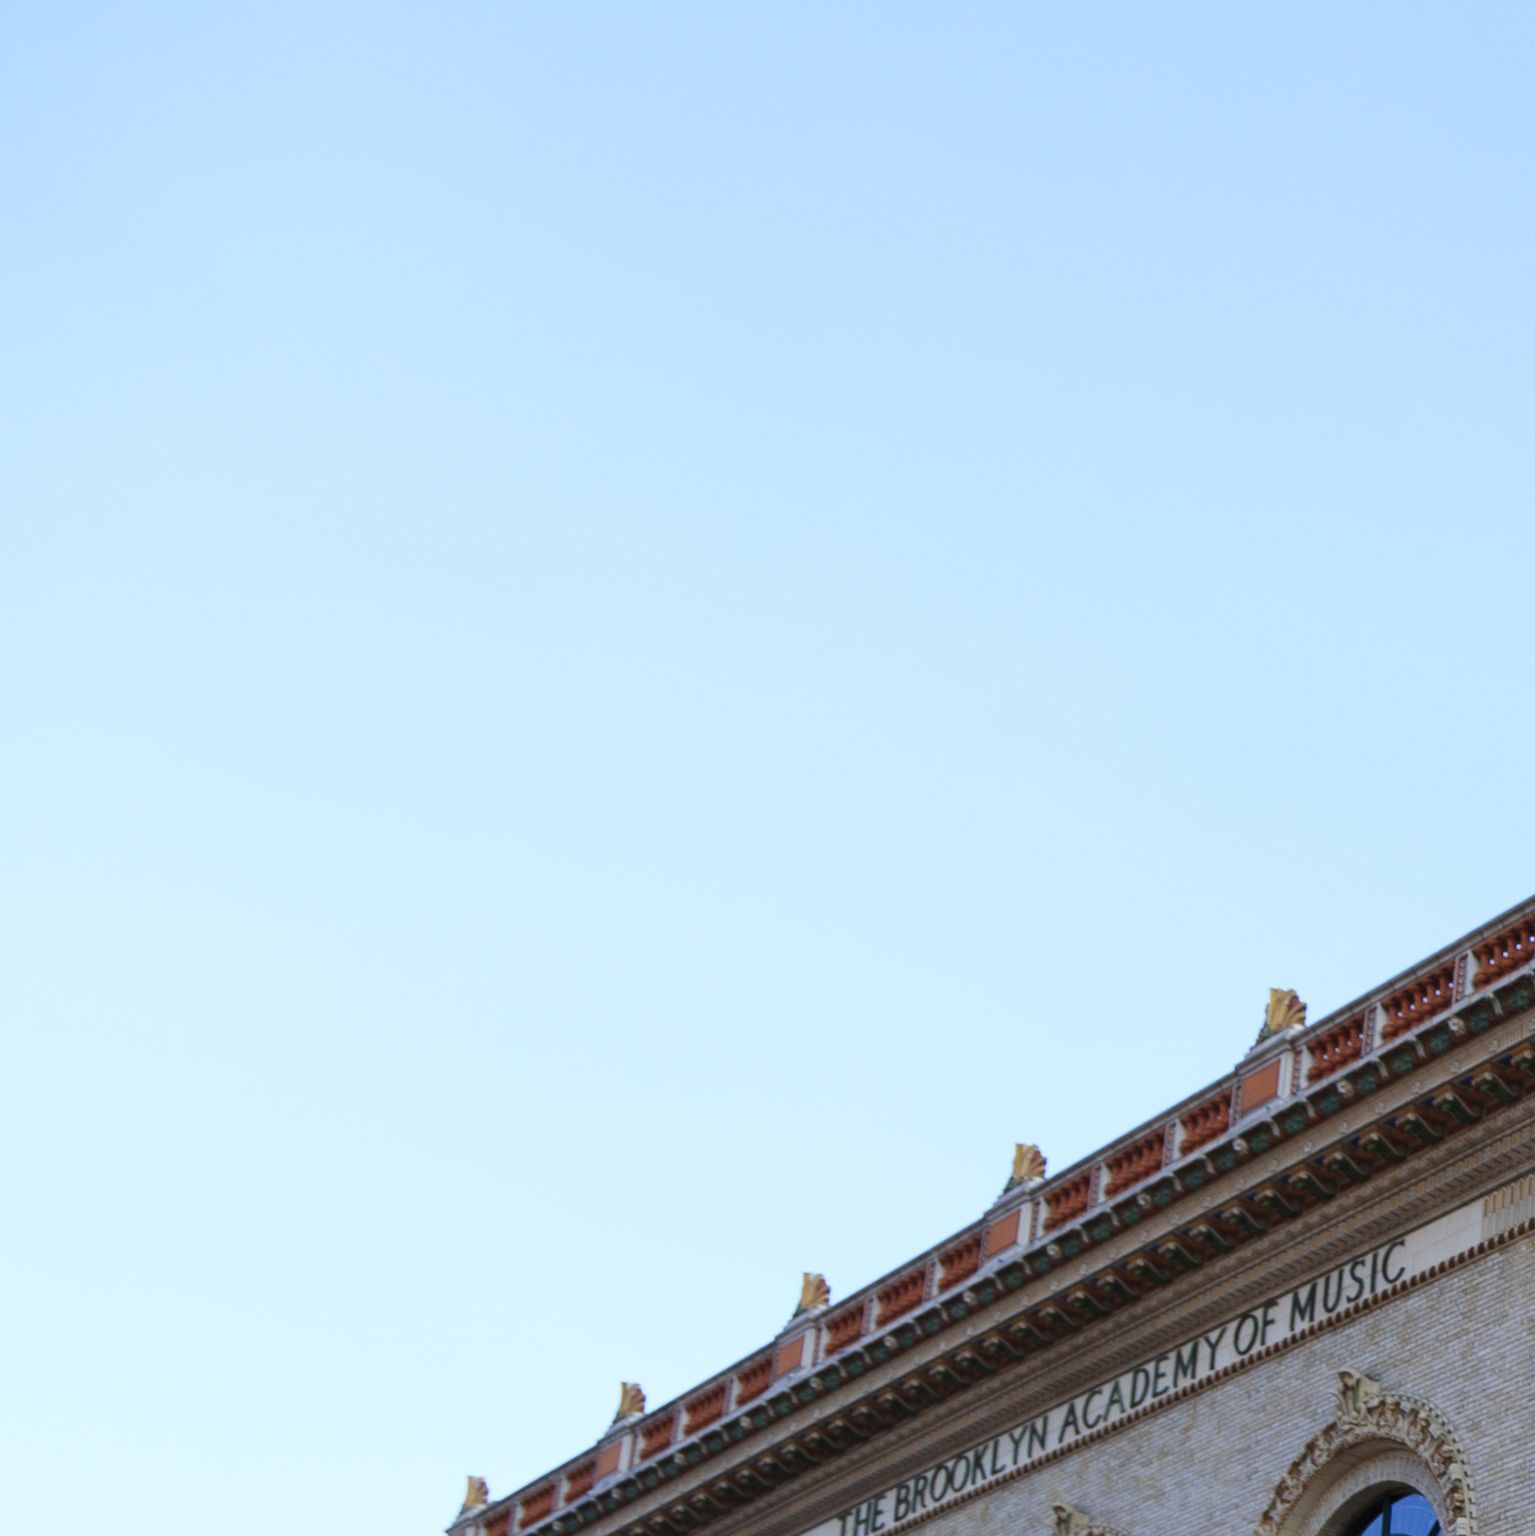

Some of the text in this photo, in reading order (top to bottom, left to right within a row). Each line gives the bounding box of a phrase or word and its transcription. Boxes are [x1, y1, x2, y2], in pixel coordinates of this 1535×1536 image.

[894, 1415, 1049, 1523] BROOKLYN
[1058, 1326, 1228, 1444] ACADEMY
[1233, 1299, 1280, 1356] OF
[1290, 1238, 1406, 1332] MUSIC
